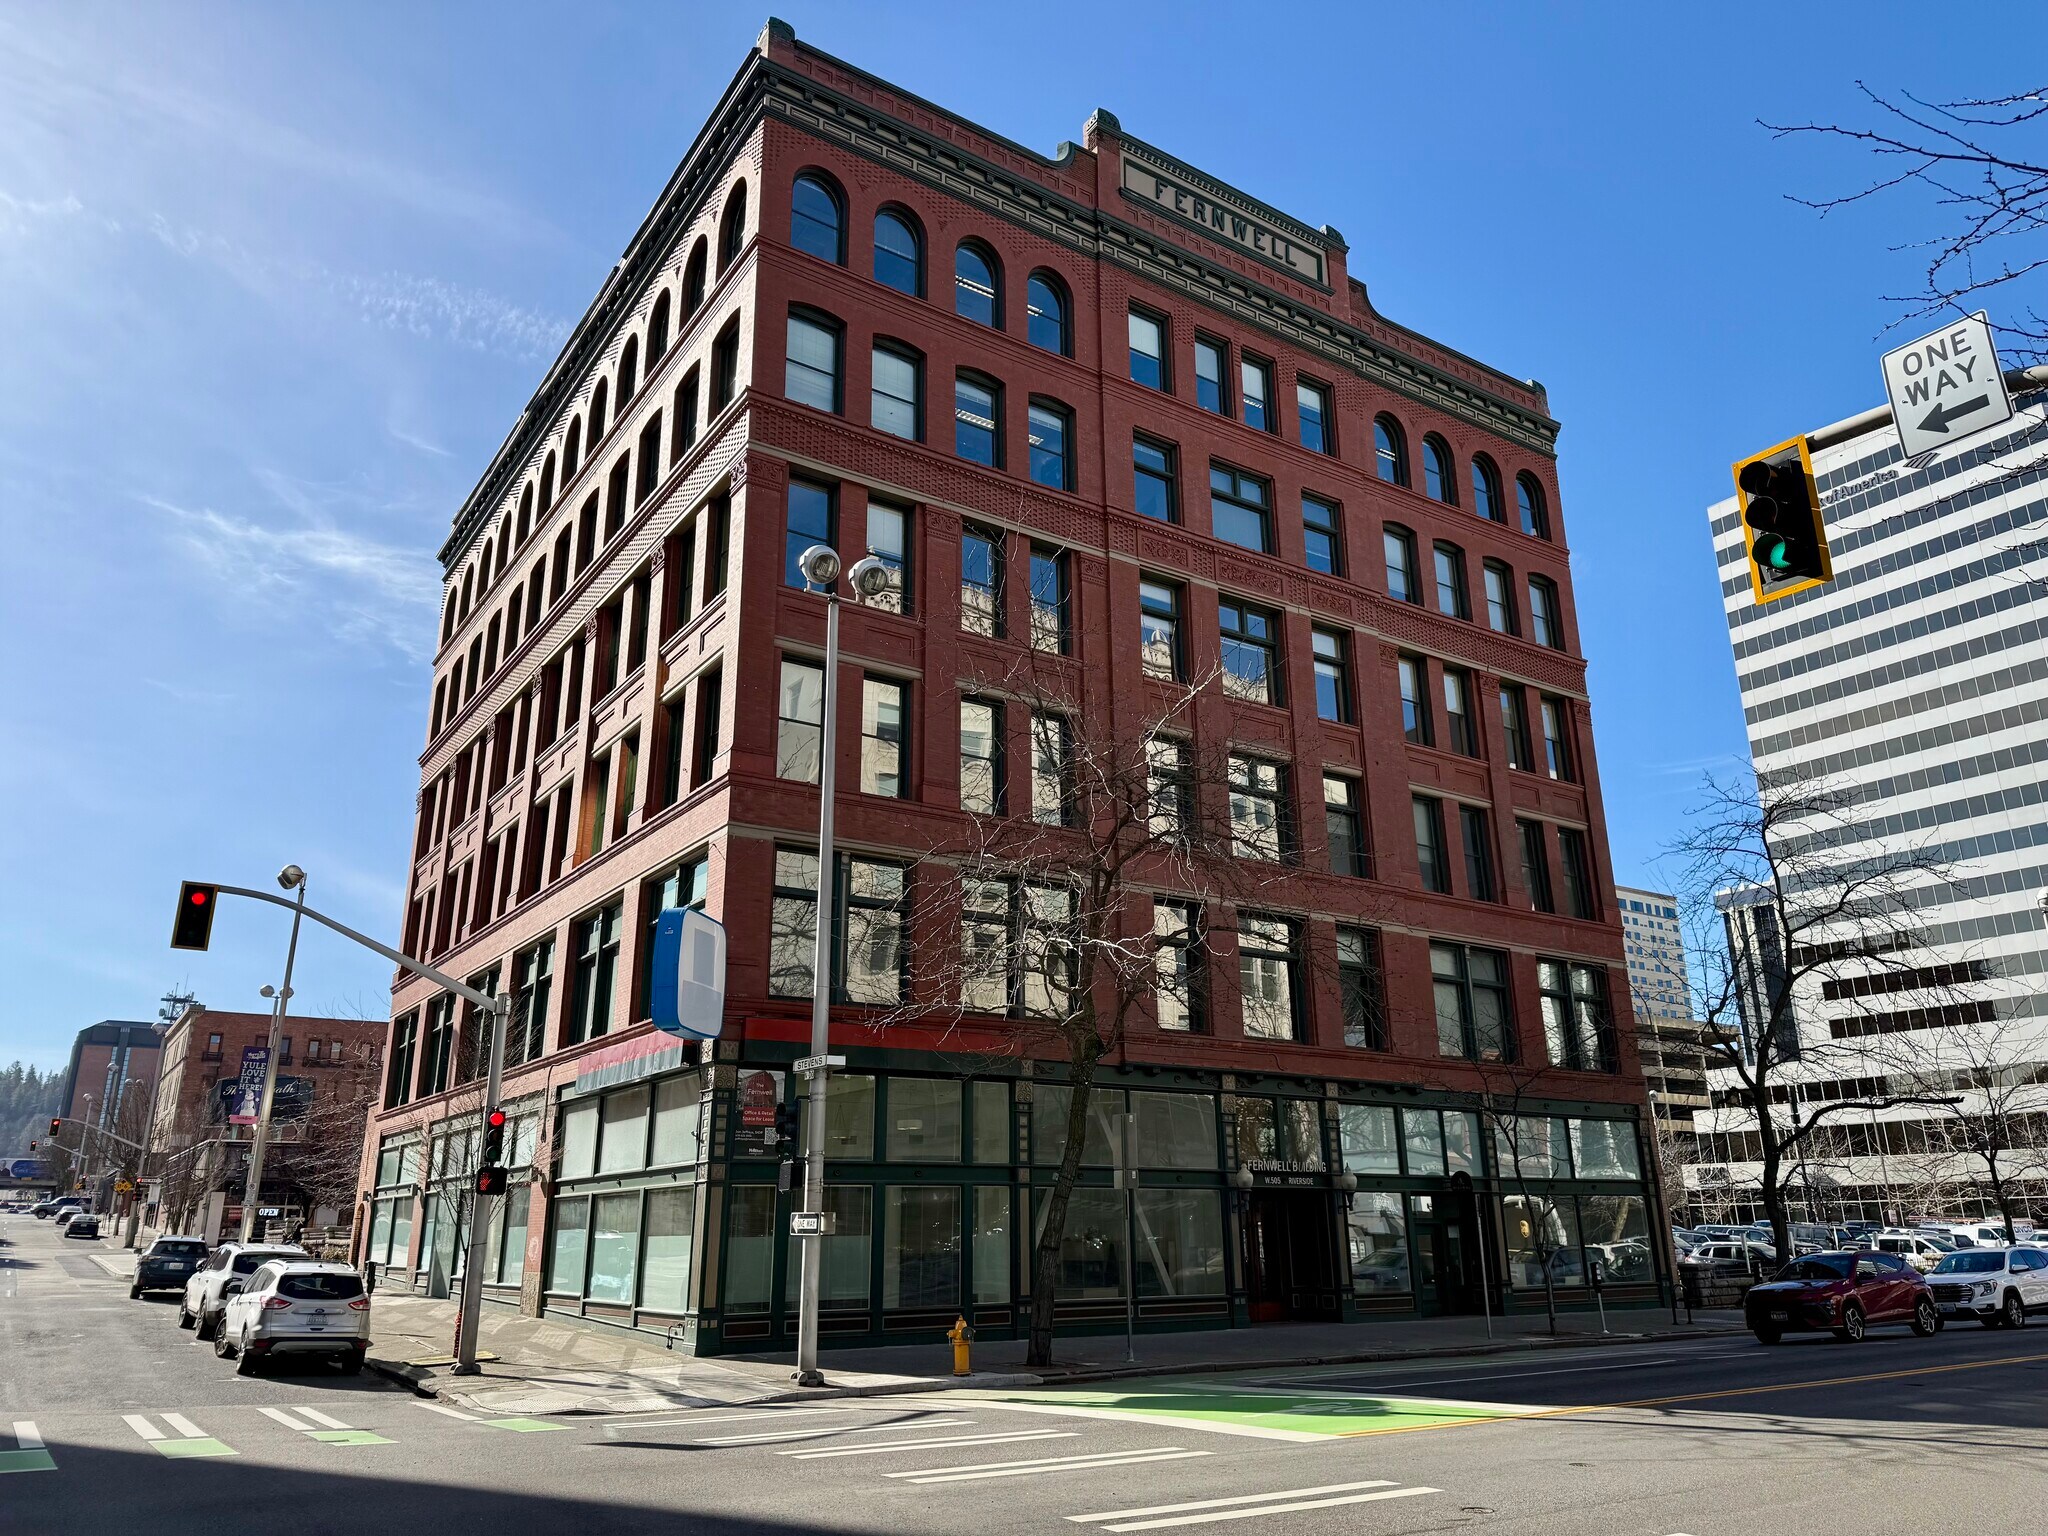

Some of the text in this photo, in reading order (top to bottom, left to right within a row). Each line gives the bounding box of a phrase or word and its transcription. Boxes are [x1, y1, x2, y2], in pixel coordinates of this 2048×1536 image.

[1155, 178, 1297, 267] FERNWELL
[1902, 328, 1972, 376] ONE
[1904, 354, 1977, 407] WAY
[1824, 489, 1839, 504] of
[1839, 469, 1899, 499] America
[243, 1061, 266, 1069] YULE
[797, 1057, 822, 1069] STEVENS
[241, 1069, 265, 1077] LOVE
[1248, 1160, 1327, 1173] FERNWELL BUILDING
[259, 1208, 279, 1216] OPEN
